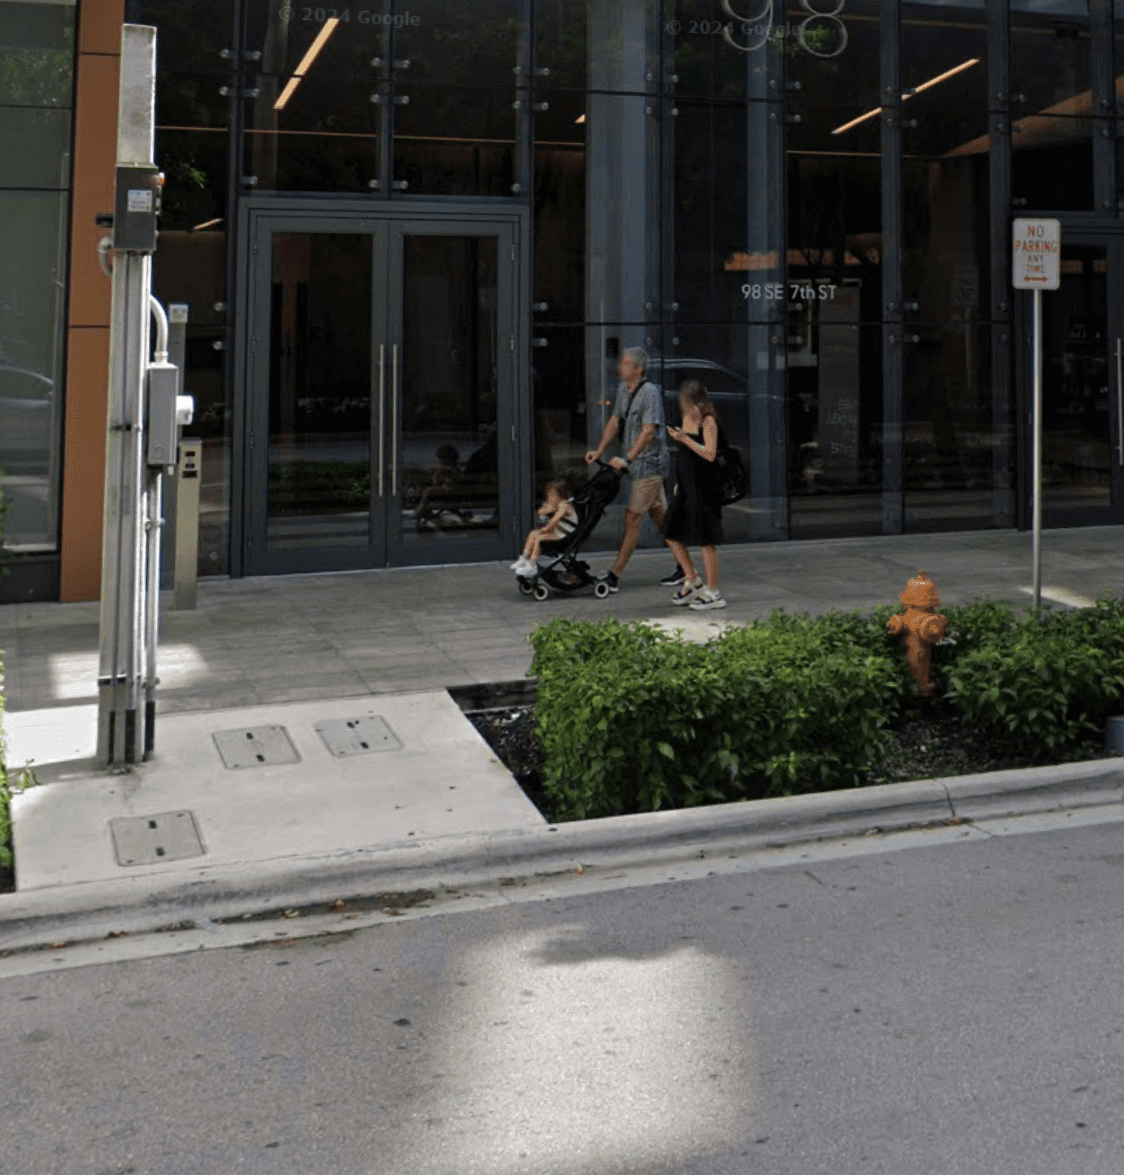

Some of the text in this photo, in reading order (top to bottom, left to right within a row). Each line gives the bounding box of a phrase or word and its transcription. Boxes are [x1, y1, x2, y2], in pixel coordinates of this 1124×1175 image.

[1027, 225, 1044, 238] NO
[1014, 240, 1060, 254] PARKING
[1027, 254, 1044, 263] ANY
[1026, 264, 1045, 274] TIME
[741, 284, 837, 300] 98 SE 7th ST
